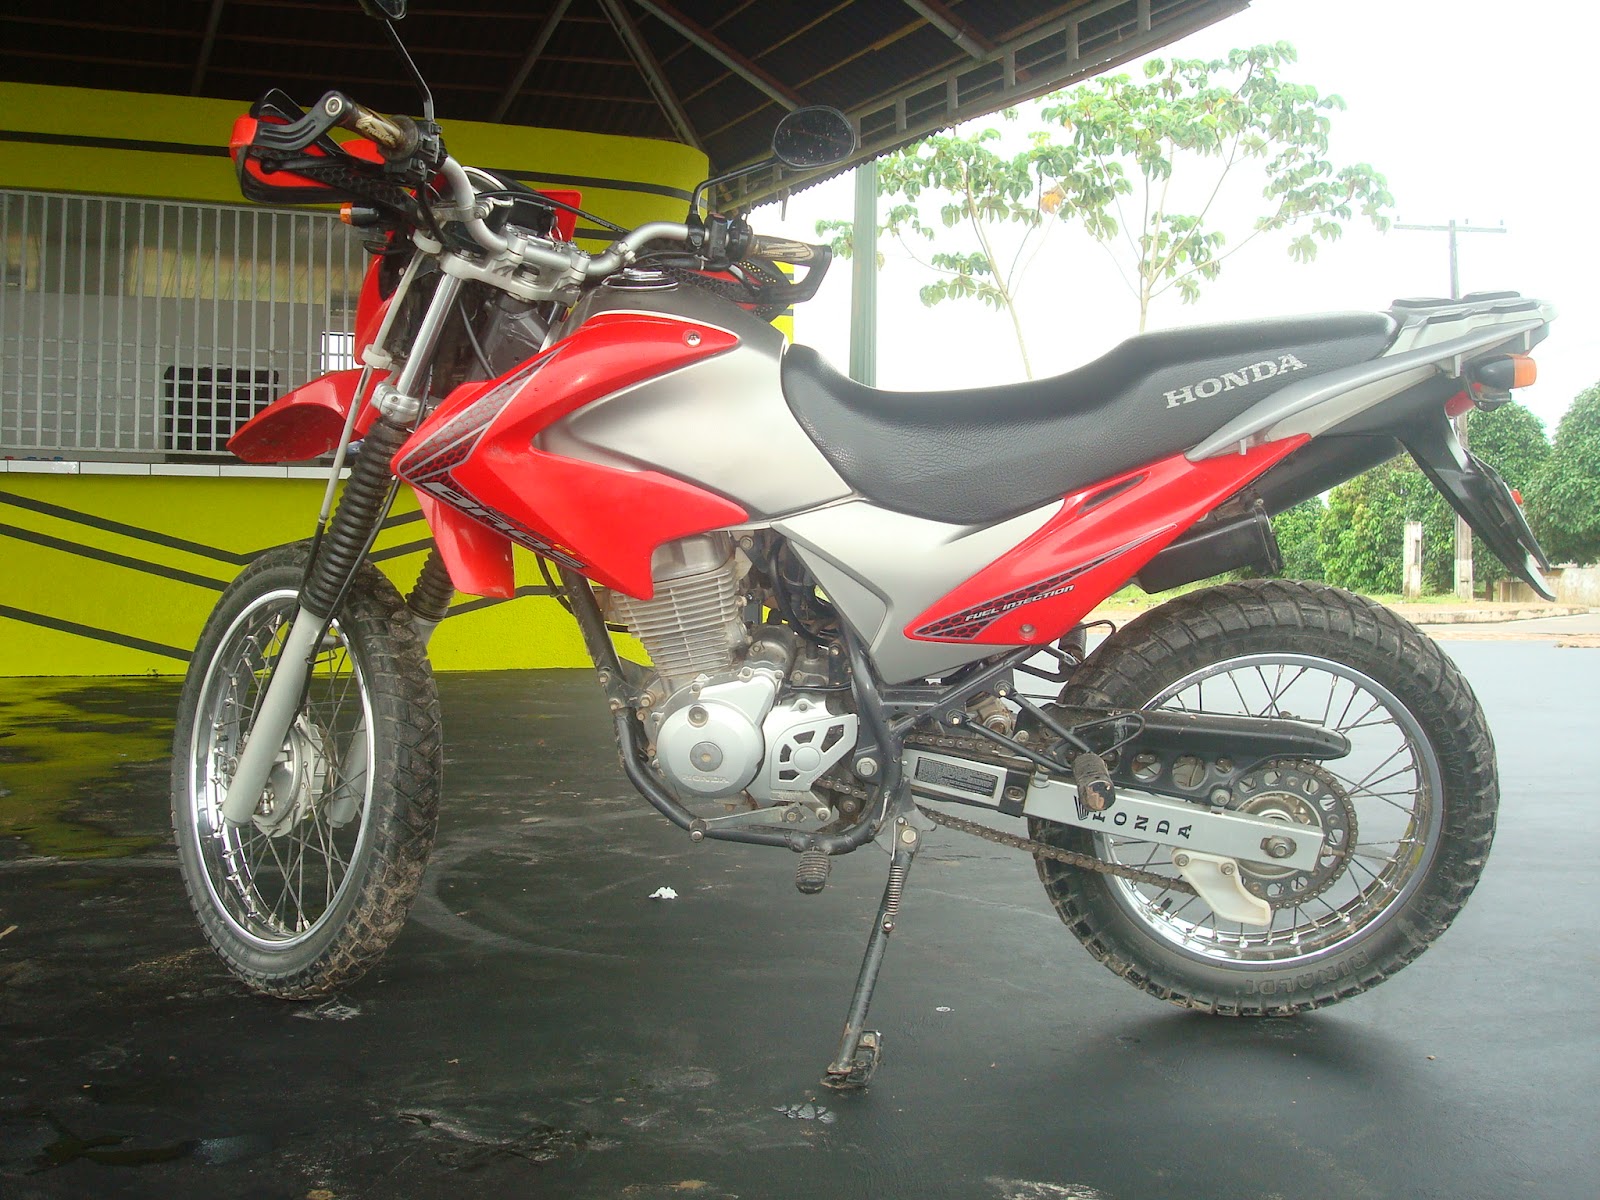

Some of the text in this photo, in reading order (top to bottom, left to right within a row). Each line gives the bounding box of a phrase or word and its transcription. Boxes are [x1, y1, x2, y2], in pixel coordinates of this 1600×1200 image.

[1163, 353, 1308, 409] HONDA
[964, 584, 1075, 622] FUEL INJECTION
[1245, 950, 1370, 995] RINALDI
